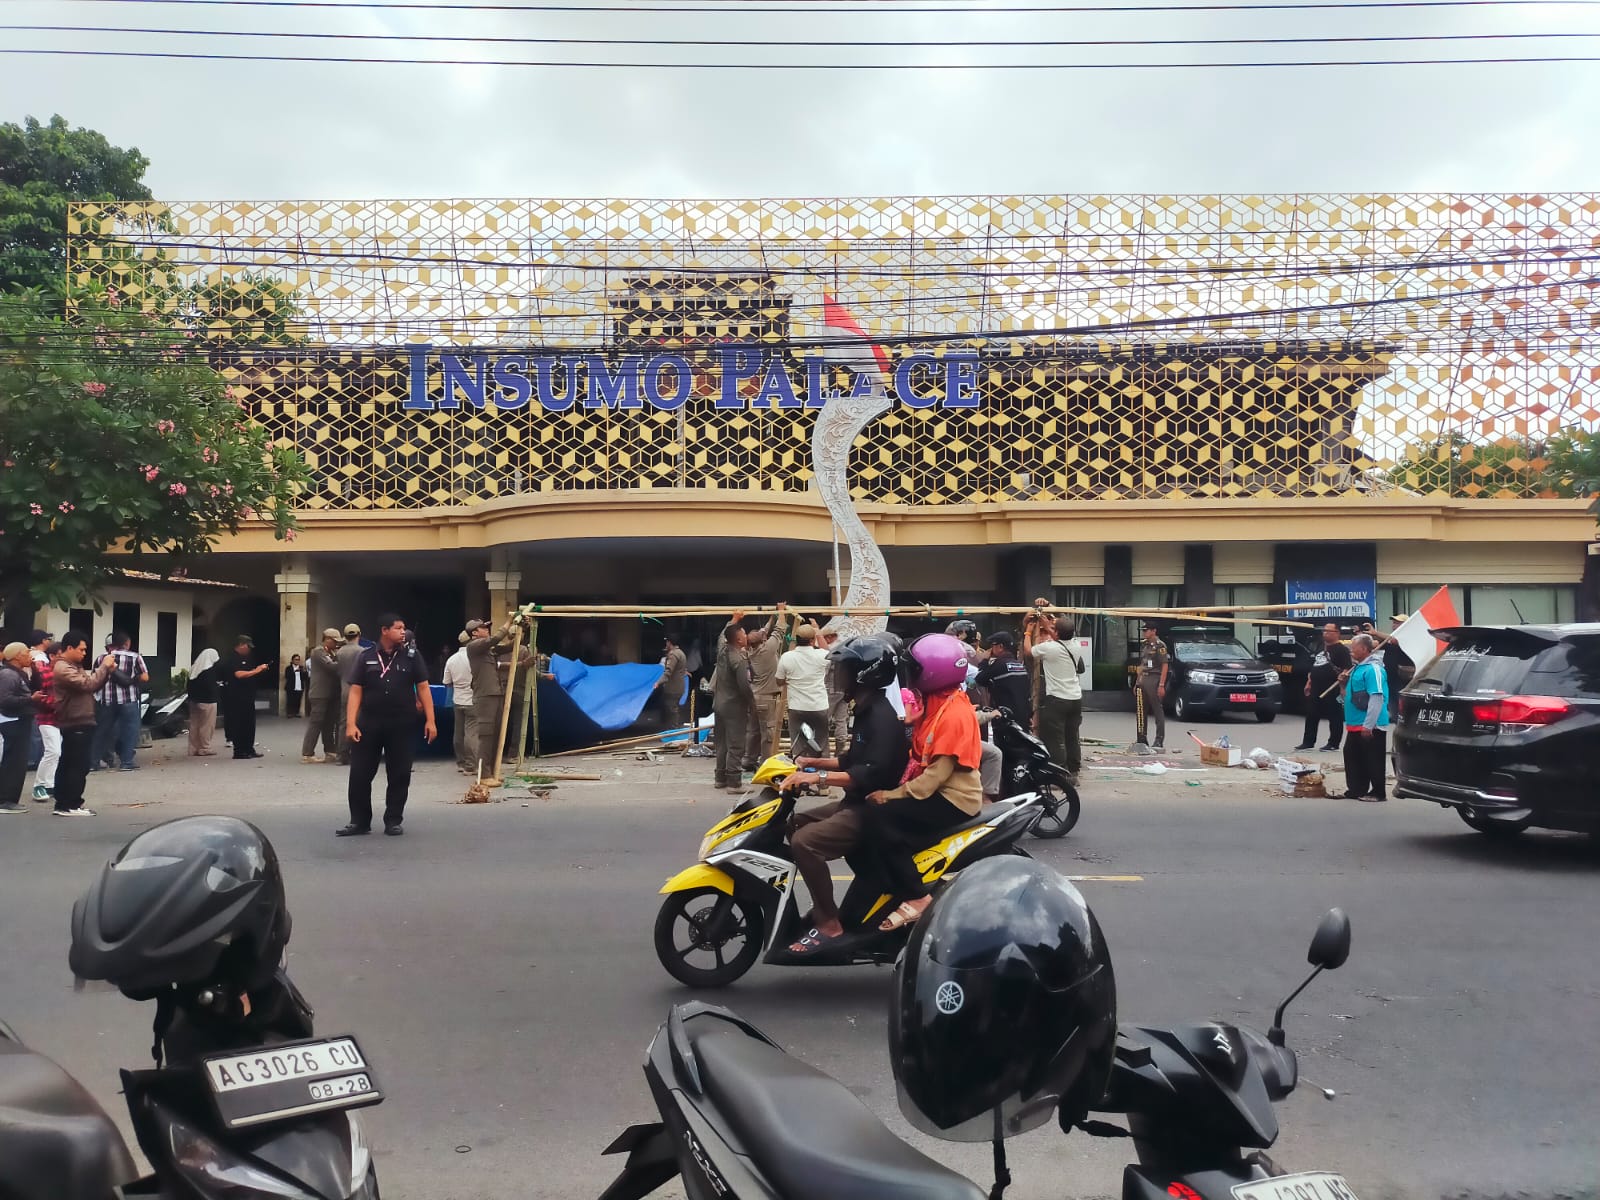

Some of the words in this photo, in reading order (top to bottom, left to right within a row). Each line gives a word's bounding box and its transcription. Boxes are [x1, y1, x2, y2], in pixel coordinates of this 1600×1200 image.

[403, 343, 693, 411] INSUMO
[714, 342, 981, 409] PALACE
[1295, 592, 1322, 600] PROMO
[1324, 591, 1347, 600] ROOM
[1348, 591, 1368, 600] ONLY
[328, 1044, 359, 1066] CU
